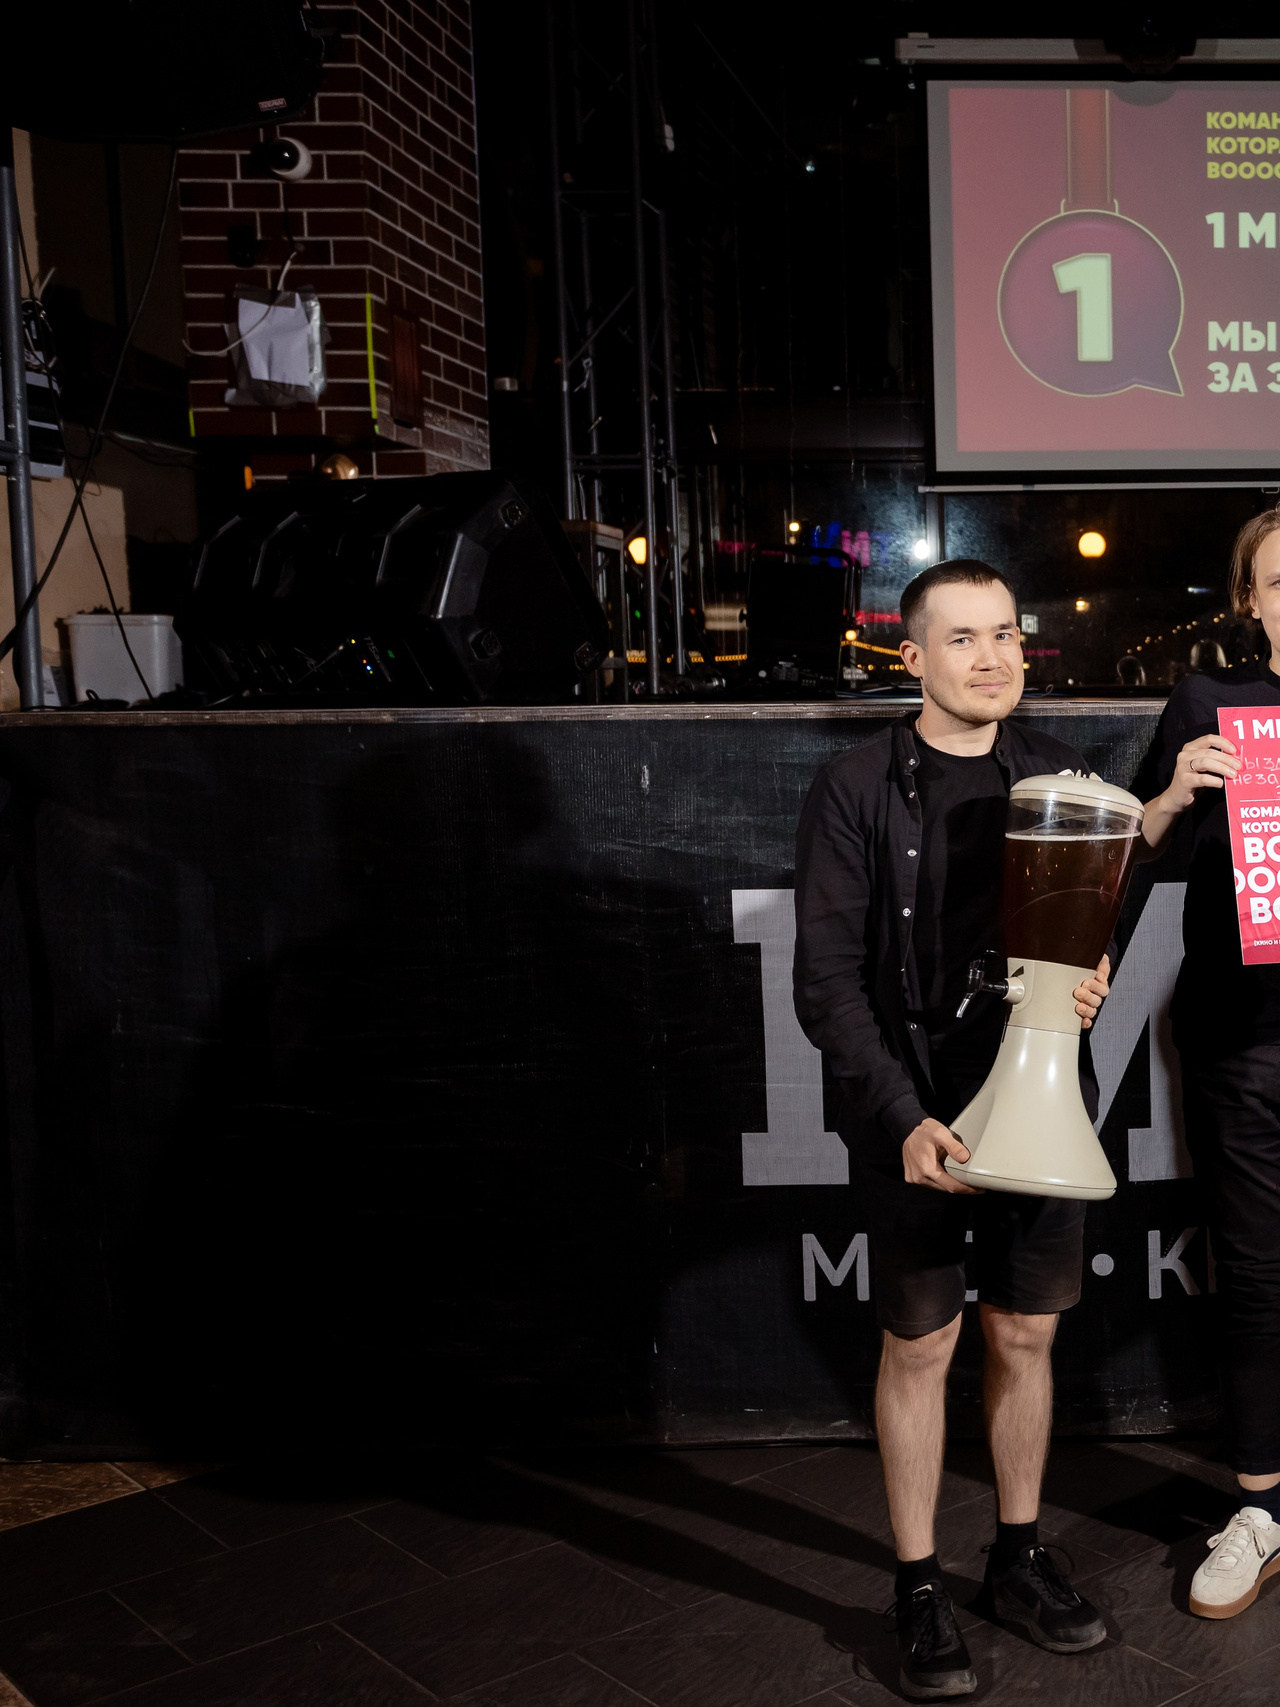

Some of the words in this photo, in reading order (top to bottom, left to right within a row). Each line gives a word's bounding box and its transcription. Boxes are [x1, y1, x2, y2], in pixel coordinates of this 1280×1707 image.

[1205, 212, 1225, 248] 1
[1052, 253, 1112, 362] 1
[1208, 321, 1277, 352] МЫ
[1207, 362, 1258, 393] ЗА
[1232, 719, 1245, 740] 1
